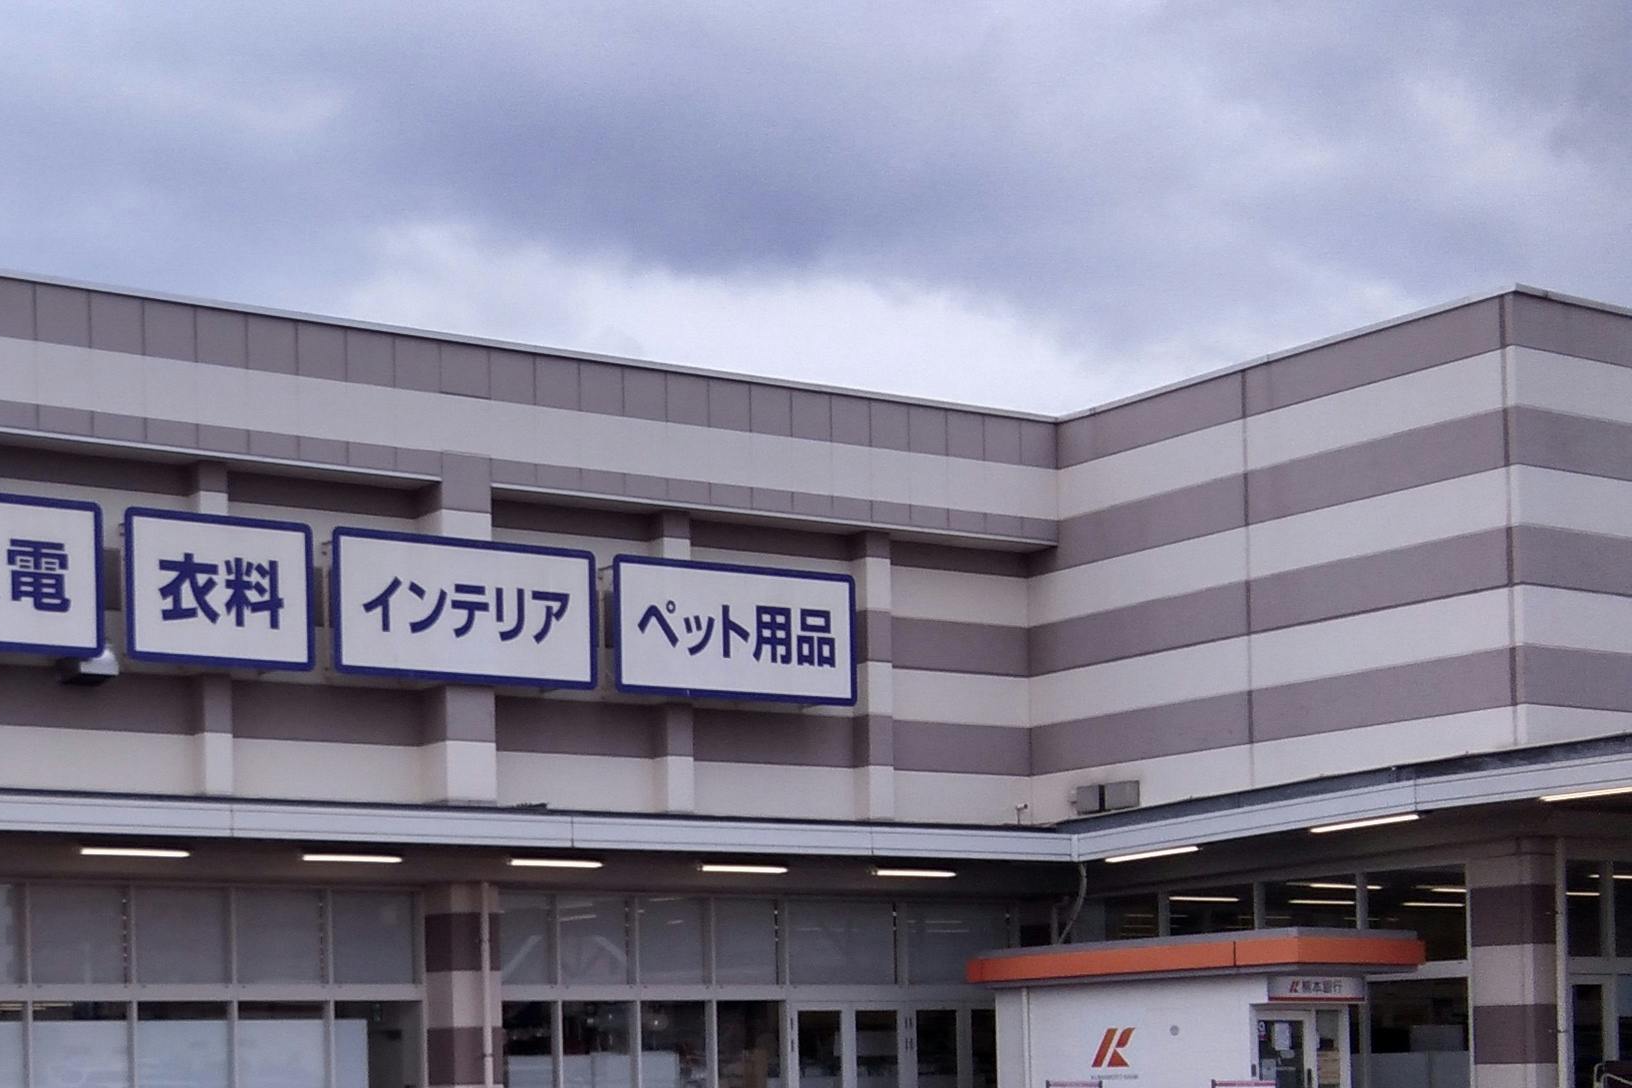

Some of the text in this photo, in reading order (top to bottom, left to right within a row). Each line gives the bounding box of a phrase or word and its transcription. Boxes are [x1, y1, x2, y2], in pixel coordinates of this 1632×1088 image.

[158, 553, 284, 630] 衣料
[363, 577, 570, 645] インテリア
[637, 600, 836, 668] ペット用品
